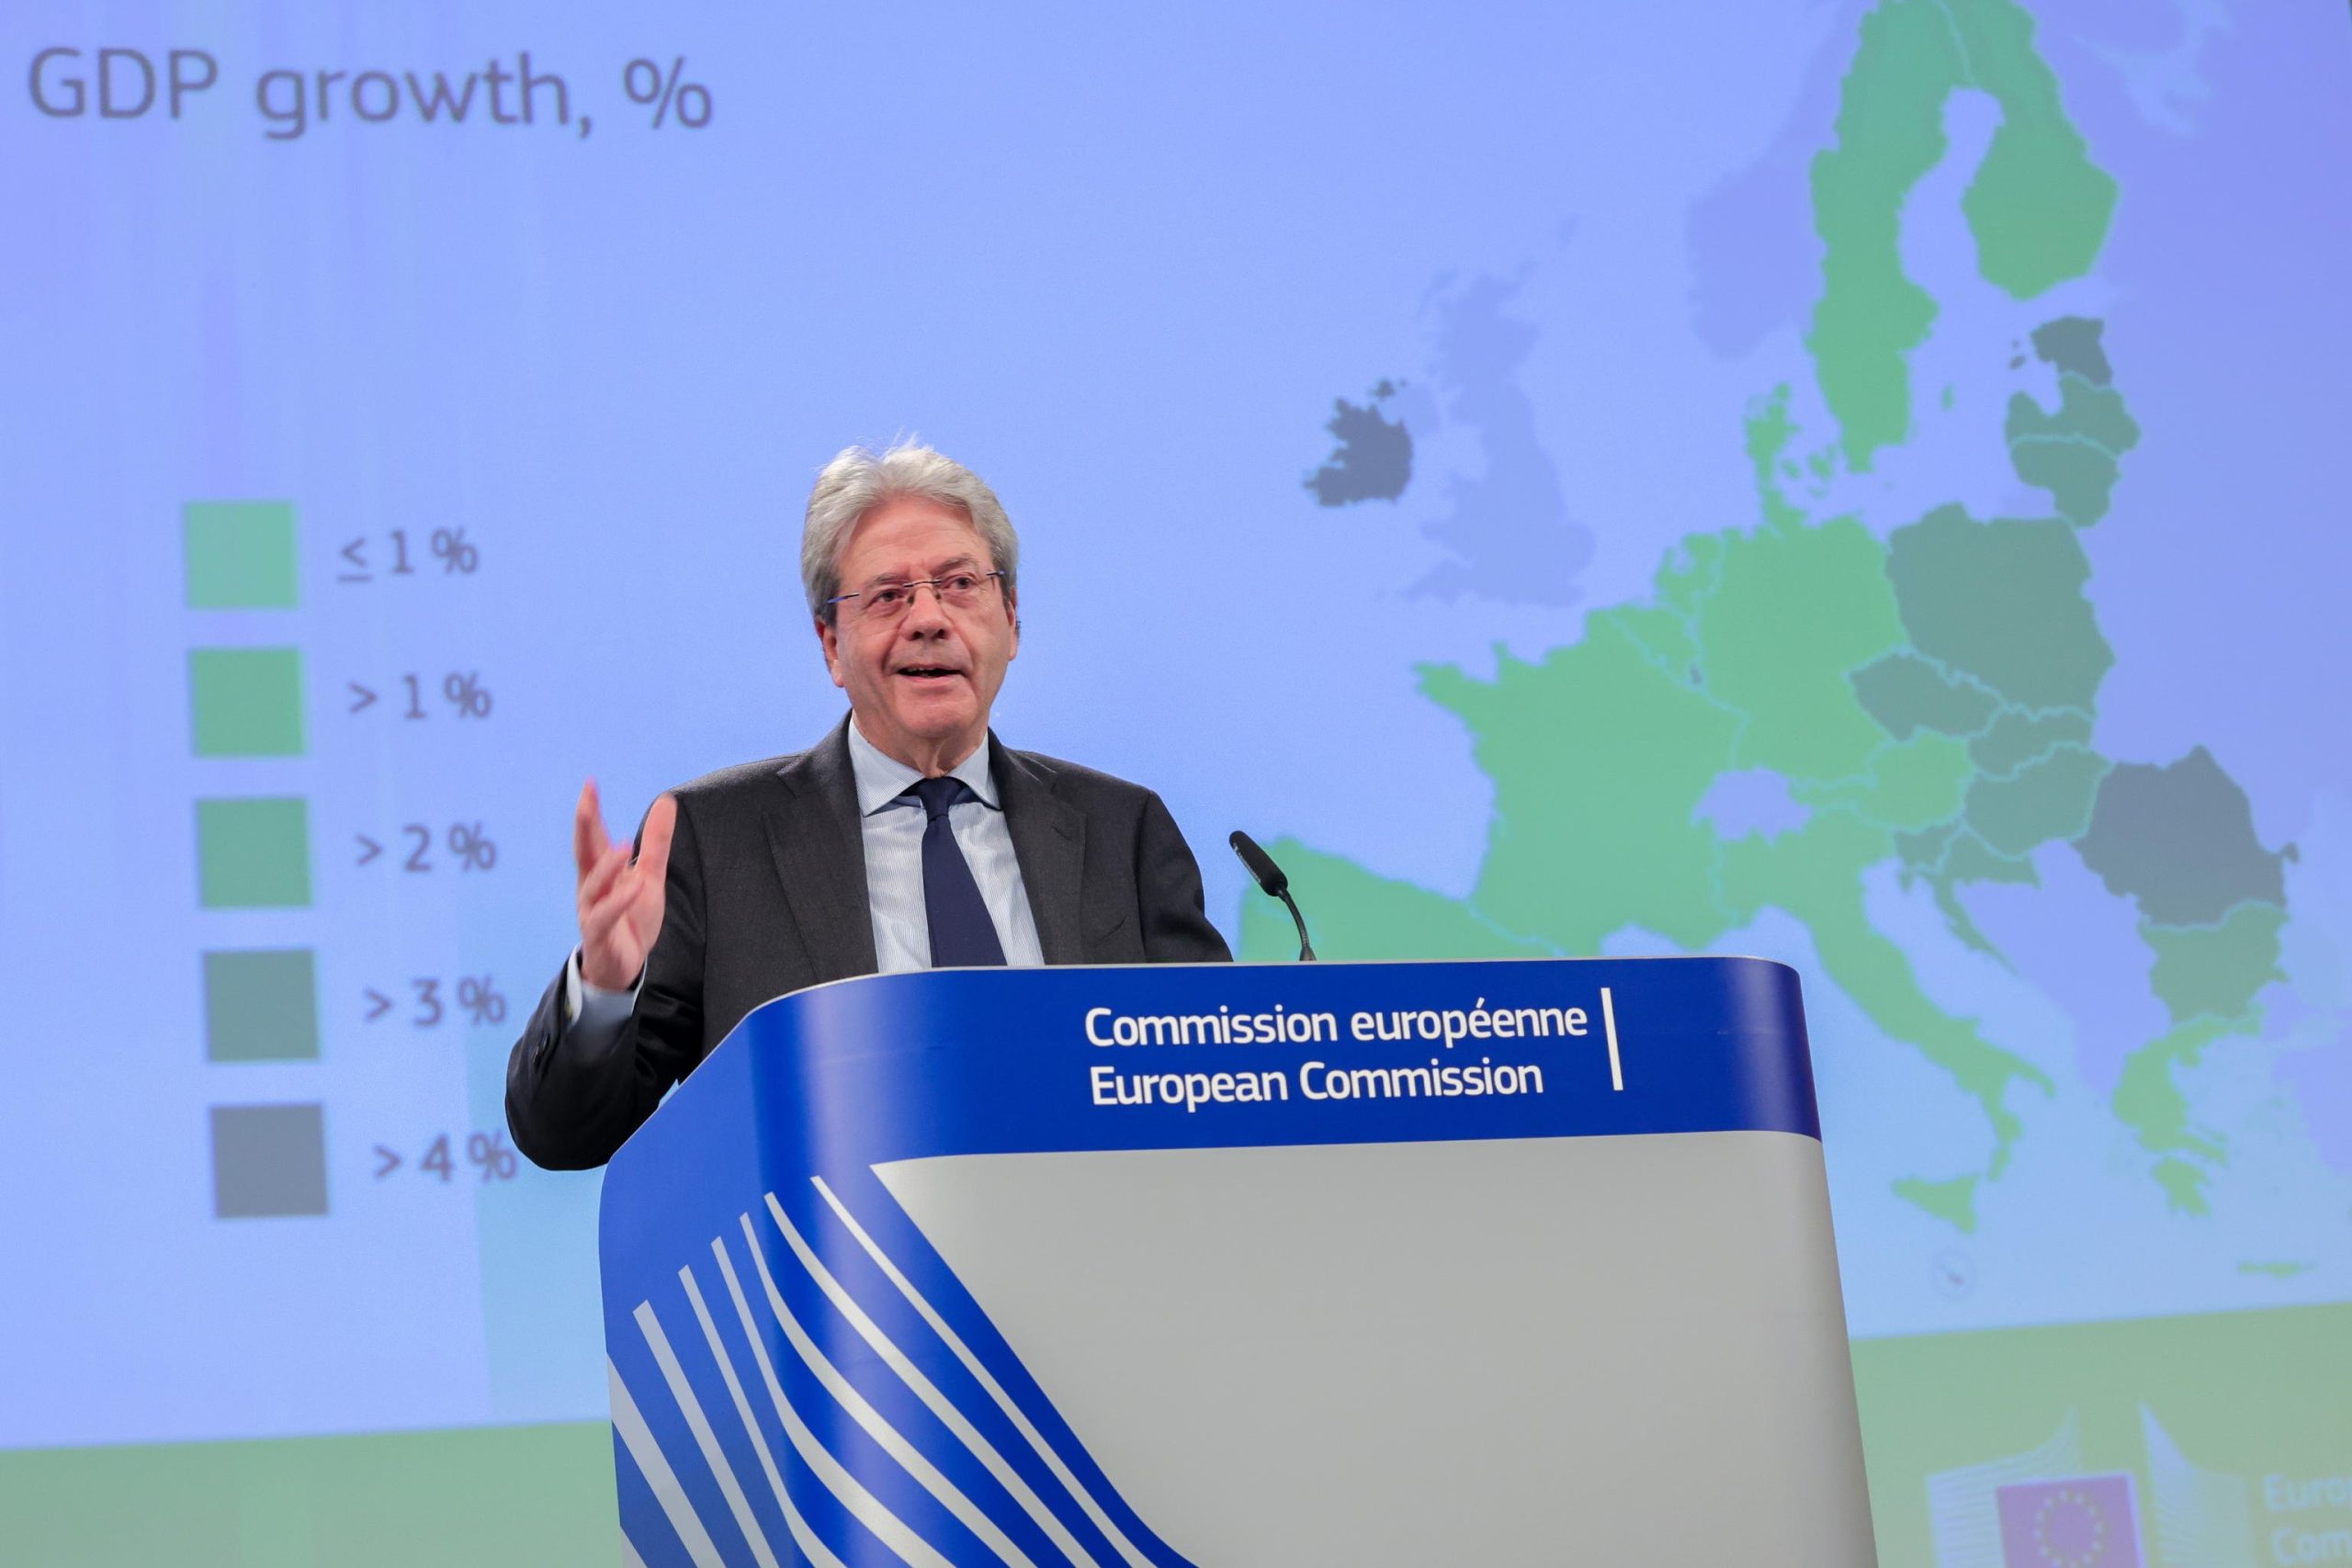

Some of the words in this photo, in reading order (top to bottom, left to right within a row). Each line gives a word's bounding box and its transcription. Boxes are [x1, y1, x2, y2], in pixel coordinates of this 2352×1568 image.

[28, 46, 219, 119] GDP
[255, 51, 593, 141] growth,
[623, 55, 713, 130] %
[390, 528, 415, 576] 1
[430, 525, 480, 575] %
[401, 673, 428, 721] 1
[442, 671, 493, 720] %
[402, 822, 433, 874] 2
[447, 821, 498, 873] %
[411, 977, 445, 1029] 3
[458, 974, 508, 1027] %
[1084, 1004, 1339, 1048] Commission
[1350, 997, 1589, 1049] européenne
[1090, 1066, 1289, 1113] European
[1299, 1057, 1544, 1101] Commission
[418, 1133, 457, 1184] 4
[467, 1130, 518, 1183] %
